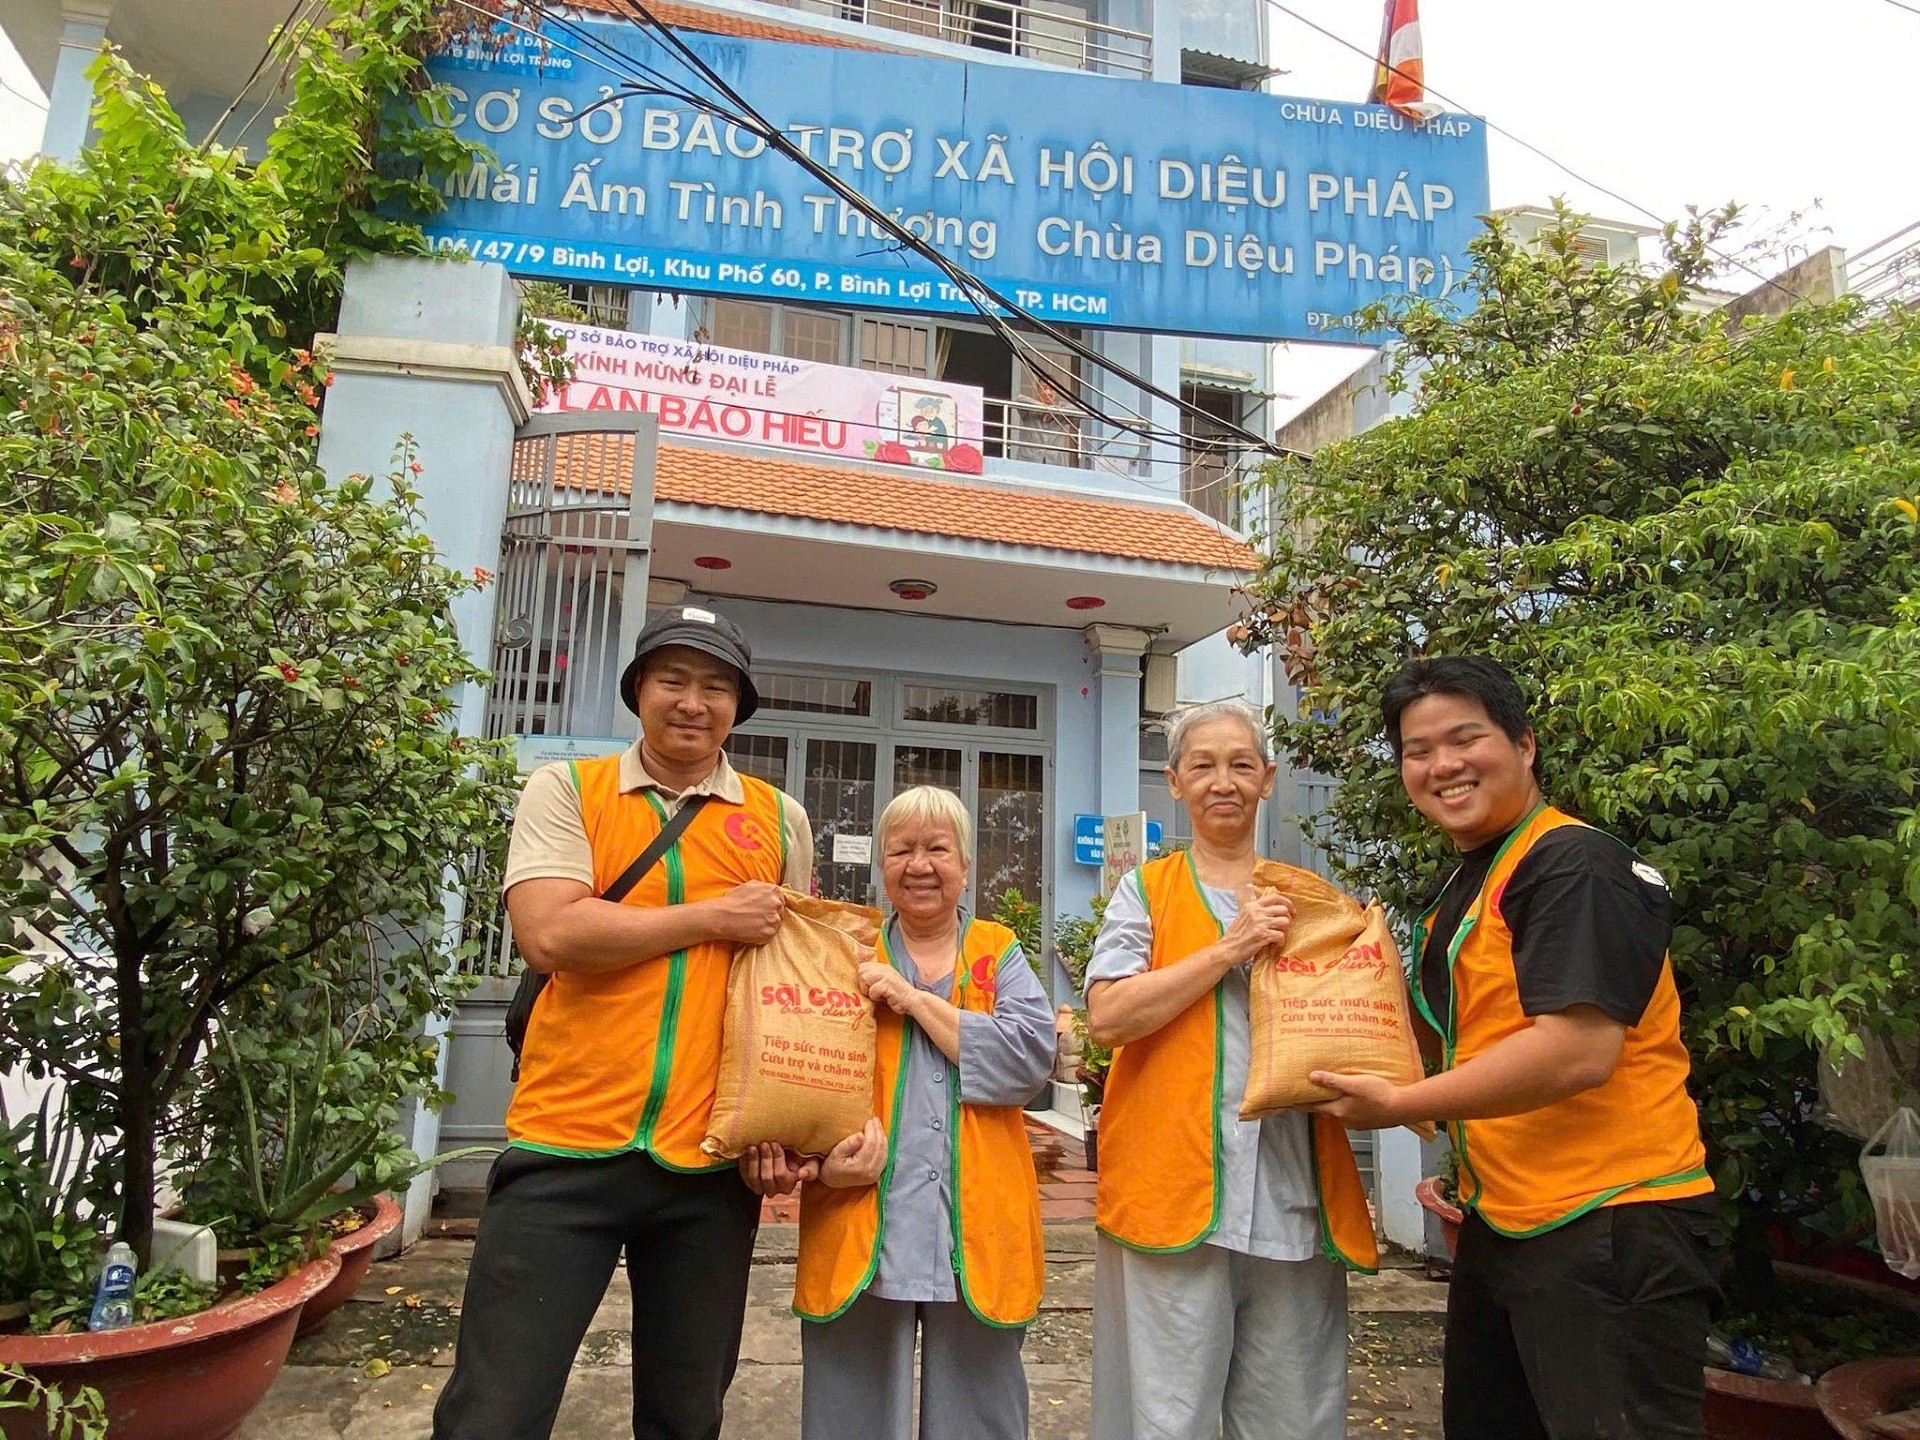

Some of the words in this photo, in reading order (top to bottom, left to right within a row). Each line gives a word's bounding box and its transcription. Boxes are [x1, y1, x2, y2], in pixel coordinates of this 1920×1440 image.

[1280, 101, 1343, 126] CHÙA
[1354, 109, 1404, 133] DIỆU
[1413, 115, 1471, 138] PHÁP
[432, 86, 521, 133] CƠ
[535, 85, 624, 144] SỞ
[788, 123, 914, 182] TRỢ
[933, 133, 1015, 185] XÃ
[1039, 141, 1133, 201] HỘI
[1159, 154, 1286, 213] DIỆU
[1308, 171, 1454, 222] PHÁP
[444, 162, 540, 205] Mái
[558, 157, 647, 217] Ấm
[669, 179, 783, 230] Tình
[1036, 216, 1163, 265] Chùa
[1184, 229, 1294, 279] Diệu
[1315, 240, 1454, 300] Pháp)
[552, 246, 606, 270] Bình
[614, 253, 655, 277] Lợi,
[664, 258, 711, 280] Khu
[718, 262, 767, 285] Phố
[770, 268, 807, 292] 60,
[814, 271, 833, 292] P.
[840, 273, 891, 297] Bình
[899, 279, 931, 303] Lợi
[1015, 289, 1044, 310] TP.
[1052, 293, 1107, 315] HCM
[552, 327, 577, 341] CƠ
[641, 340, 670, 357] TRỢ
[674, 344, 694, 359] XÃ
[728, 354, 759, 371] DIỆU
[762, 359, 800, 375] PHÁP
[573, 350, 627, 376] KÍNH
[634, 359, 703, 386] MỪNG
[709, 372, 747, 397] ĐẠI
[754, 374, 777, 398] LỄ
[558, 386, 649, 413] LAN
[659, 394, 751, 437] BÁO
[762, 408, 848, 450] HIẾU
[1372, 999, 1397, 1013] sinh
[763, 1034, 790, 1052] Tiếp
[793, 1040, 816, 1054] sức
[847, 1050, 868, 1063] sinh
[787, 1056, 805, 1071] trợ
[807, 1058, 821, 1071] và
